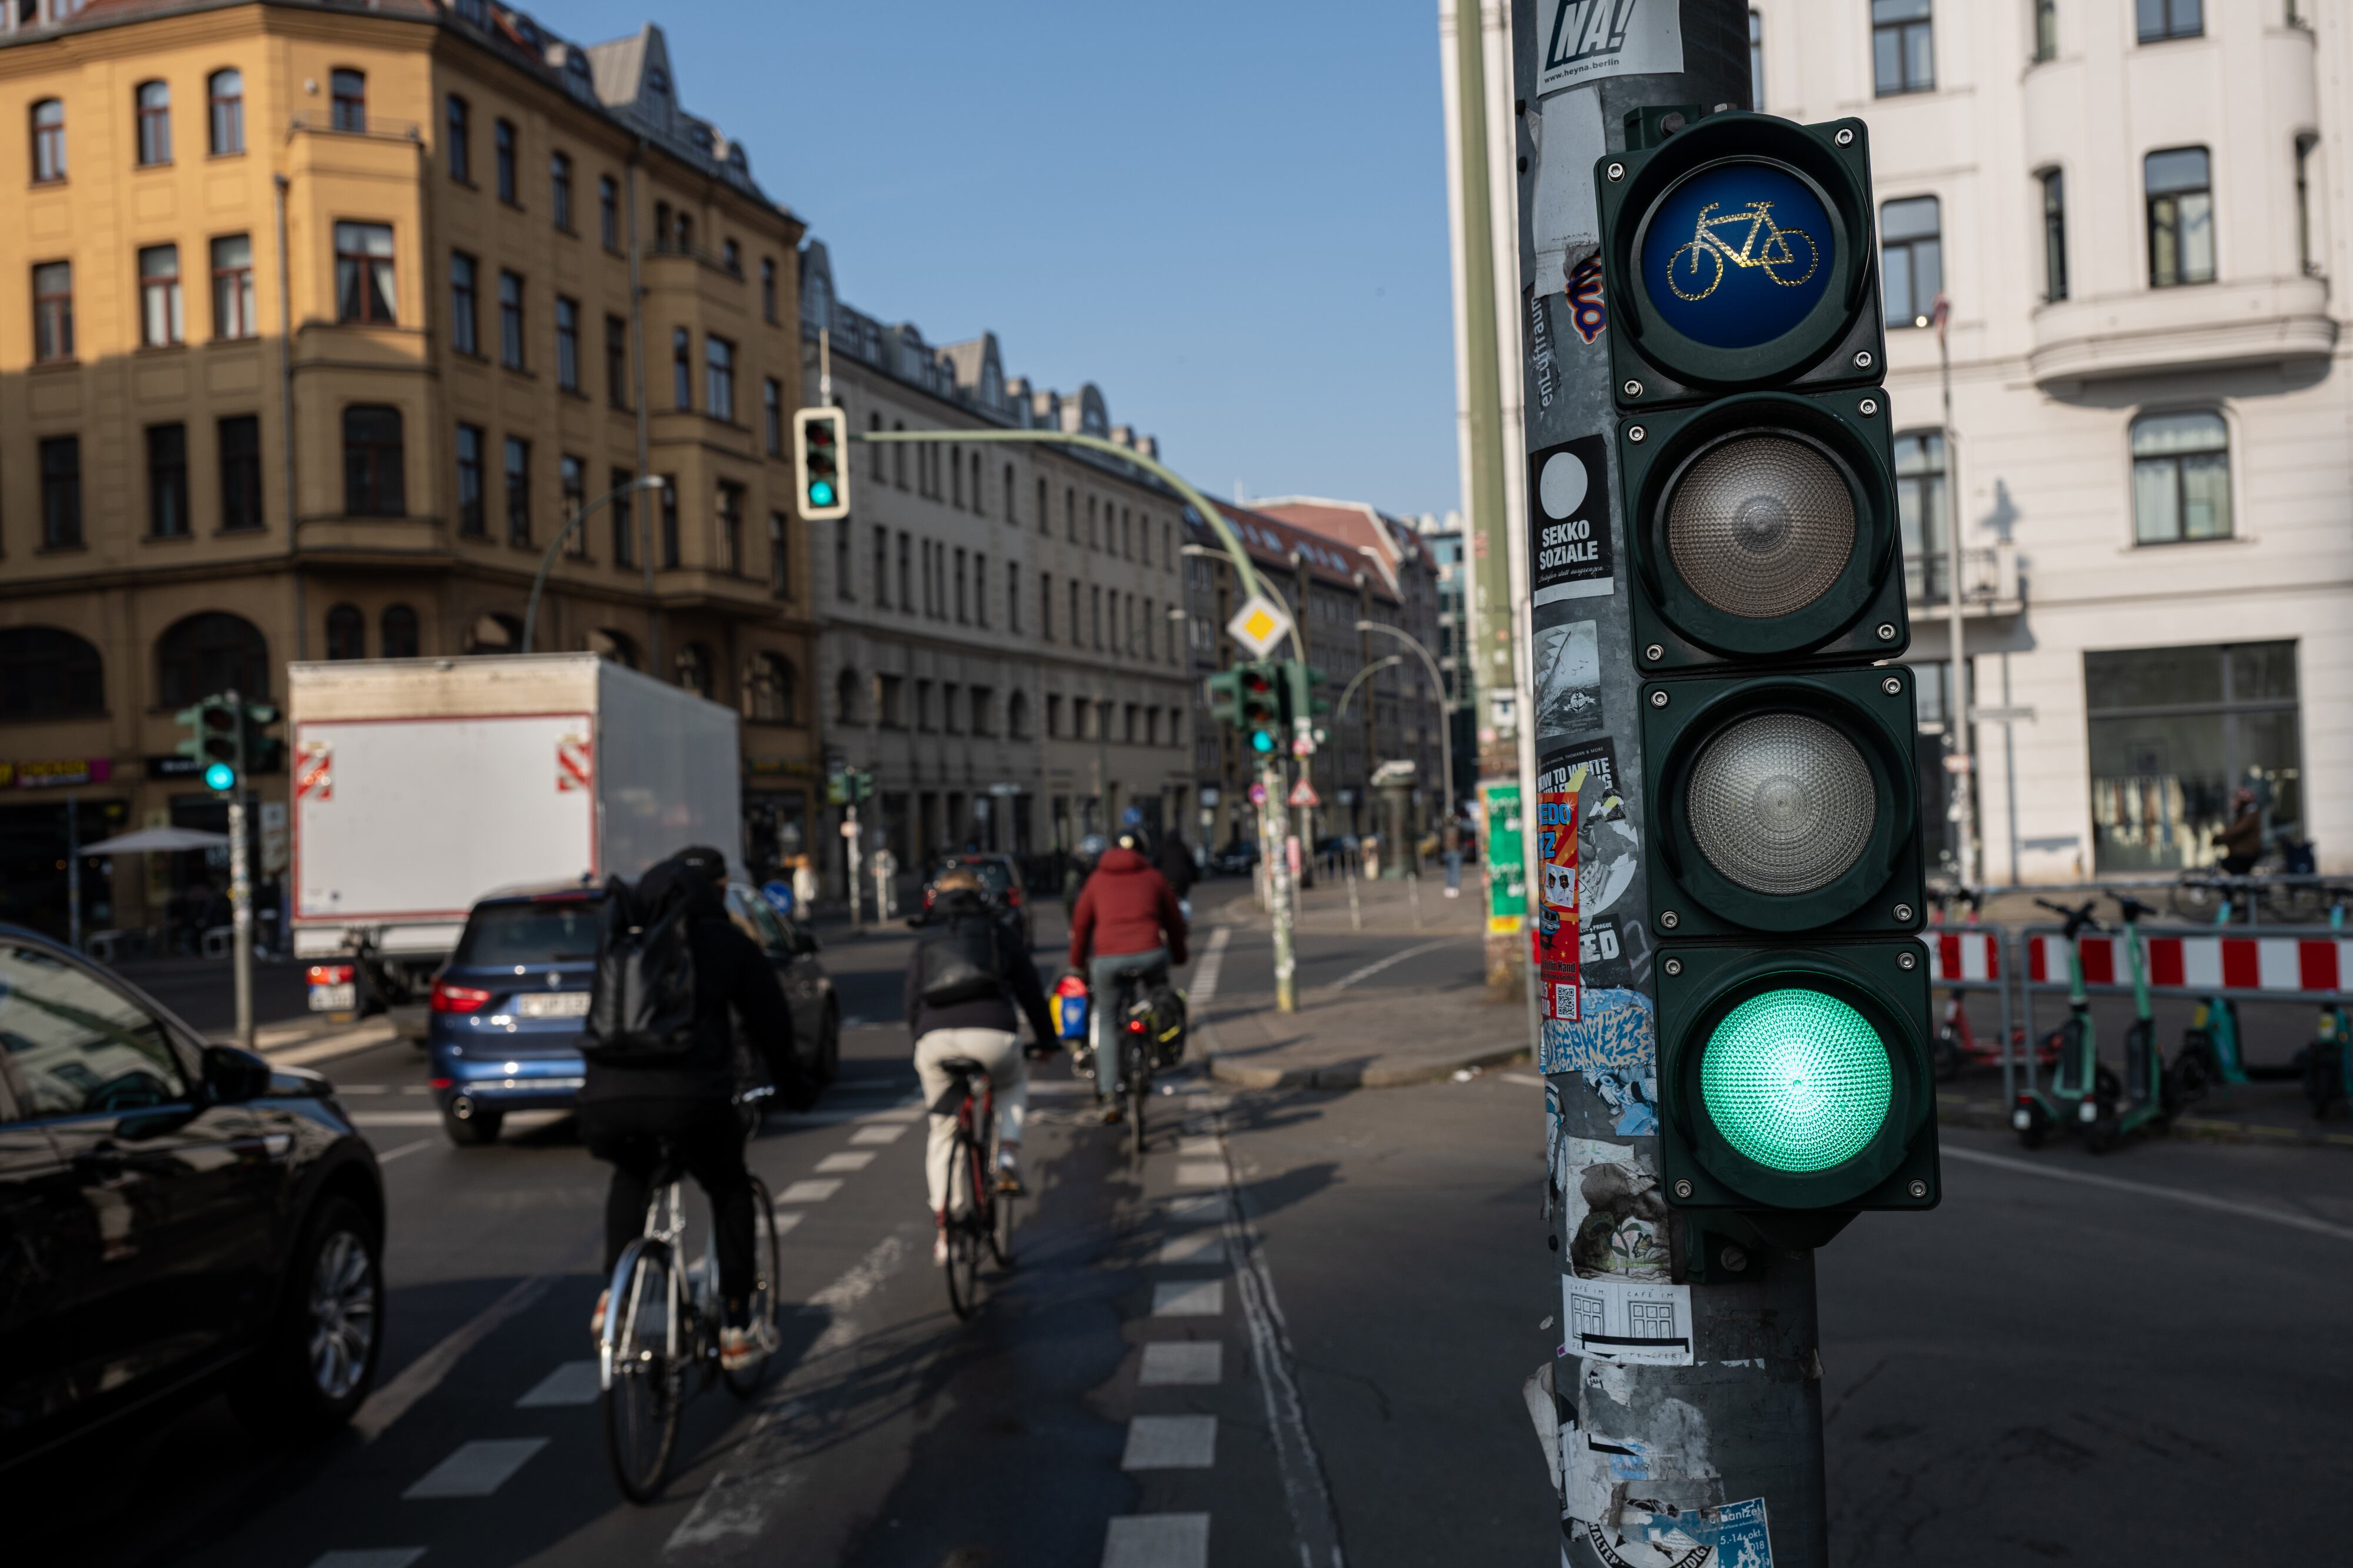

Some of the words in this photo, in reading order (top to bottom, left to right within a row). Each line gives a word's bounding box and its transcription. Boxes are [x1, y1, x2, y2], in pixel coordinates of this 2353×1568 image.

[1544, 58, 1619, 83] www.heyna.berlin
[1542, 520, 1589, 547] SEKKO
[1539, 541, 1598, 570] SOZIALE
[1565, 750, 1585, 759] THOMANN
[1538, 772, 1552, 792] HOW
[1553, 767, 1567, 785] TO
[1592, 922, 1612, 930] PRAGUE
[1558, 961, 1576, 973] Hand
[1571, 1284, 1588, 1292] CAFÉ
[1628, 1289, 1654, 1297] CAFÉ
[1748, 1529, 1763, 1539] okt.
